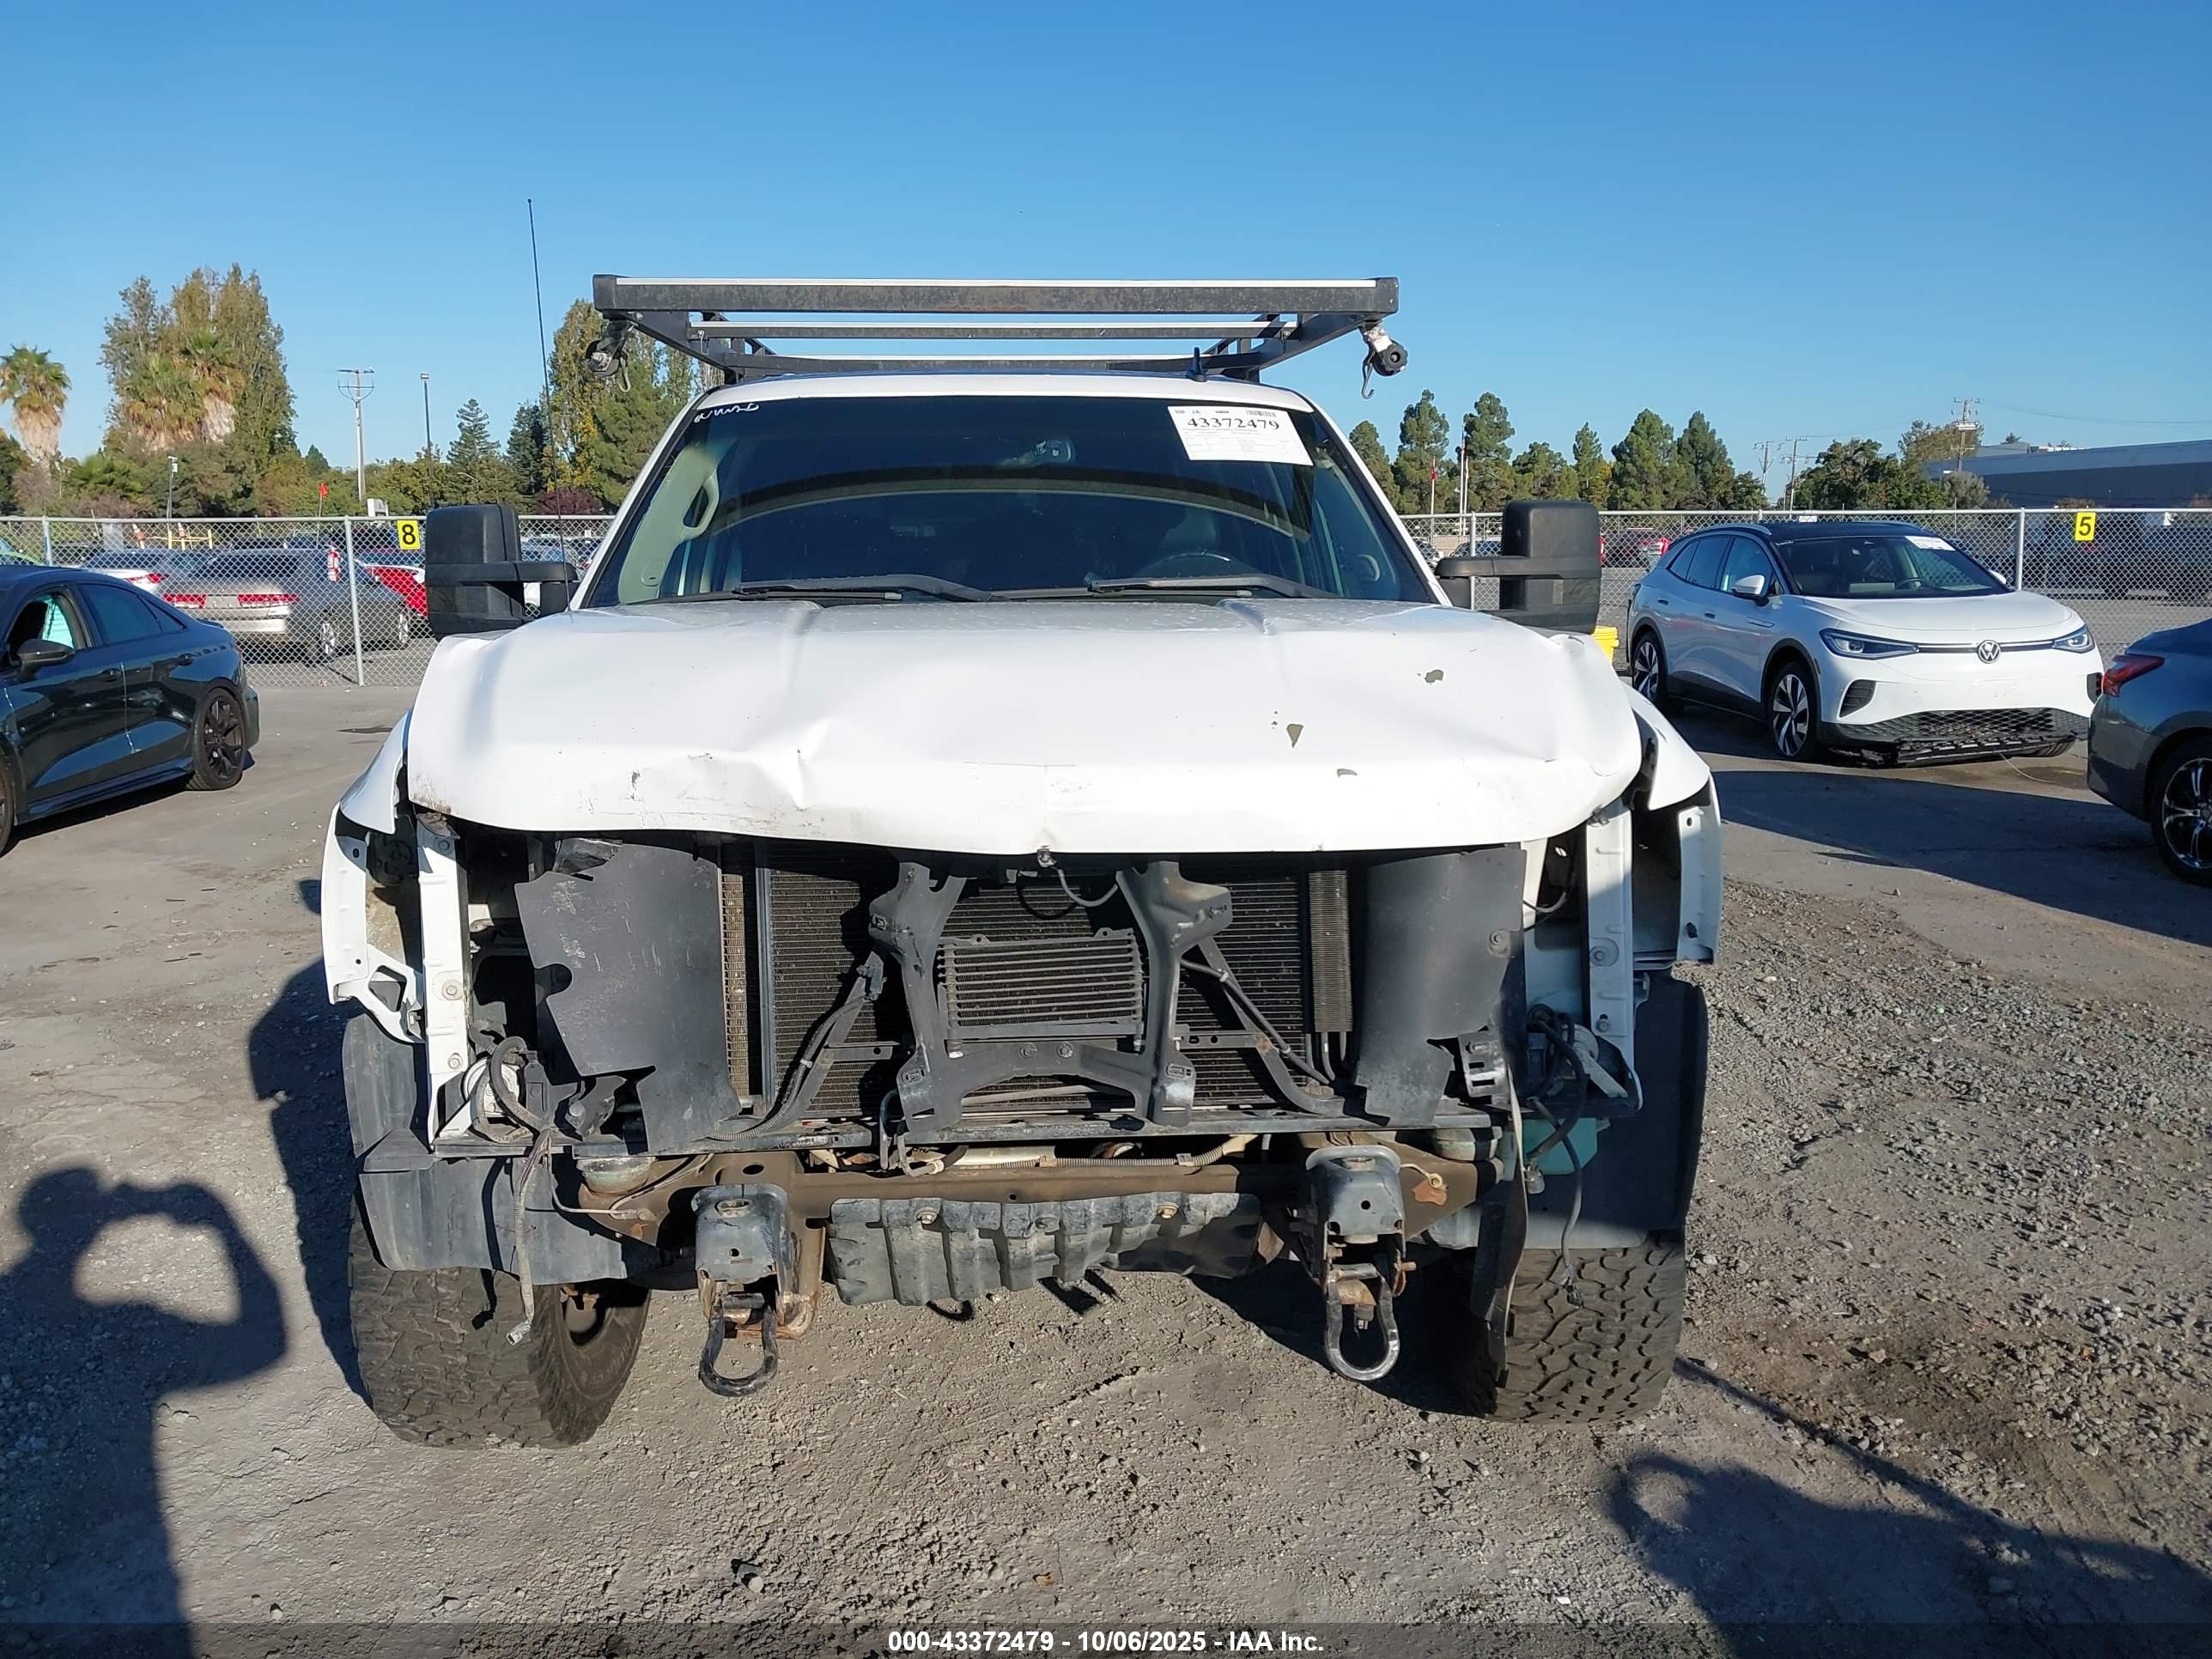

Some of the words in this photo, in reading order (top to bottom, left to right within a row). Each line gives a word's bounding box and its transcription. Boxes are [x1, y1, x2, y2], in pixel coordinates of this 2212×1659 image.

[1188, 417, 1280, 430] 43372479
[401, 524, 416, 545] 8
[2078, 516, 2092, 537] 5
